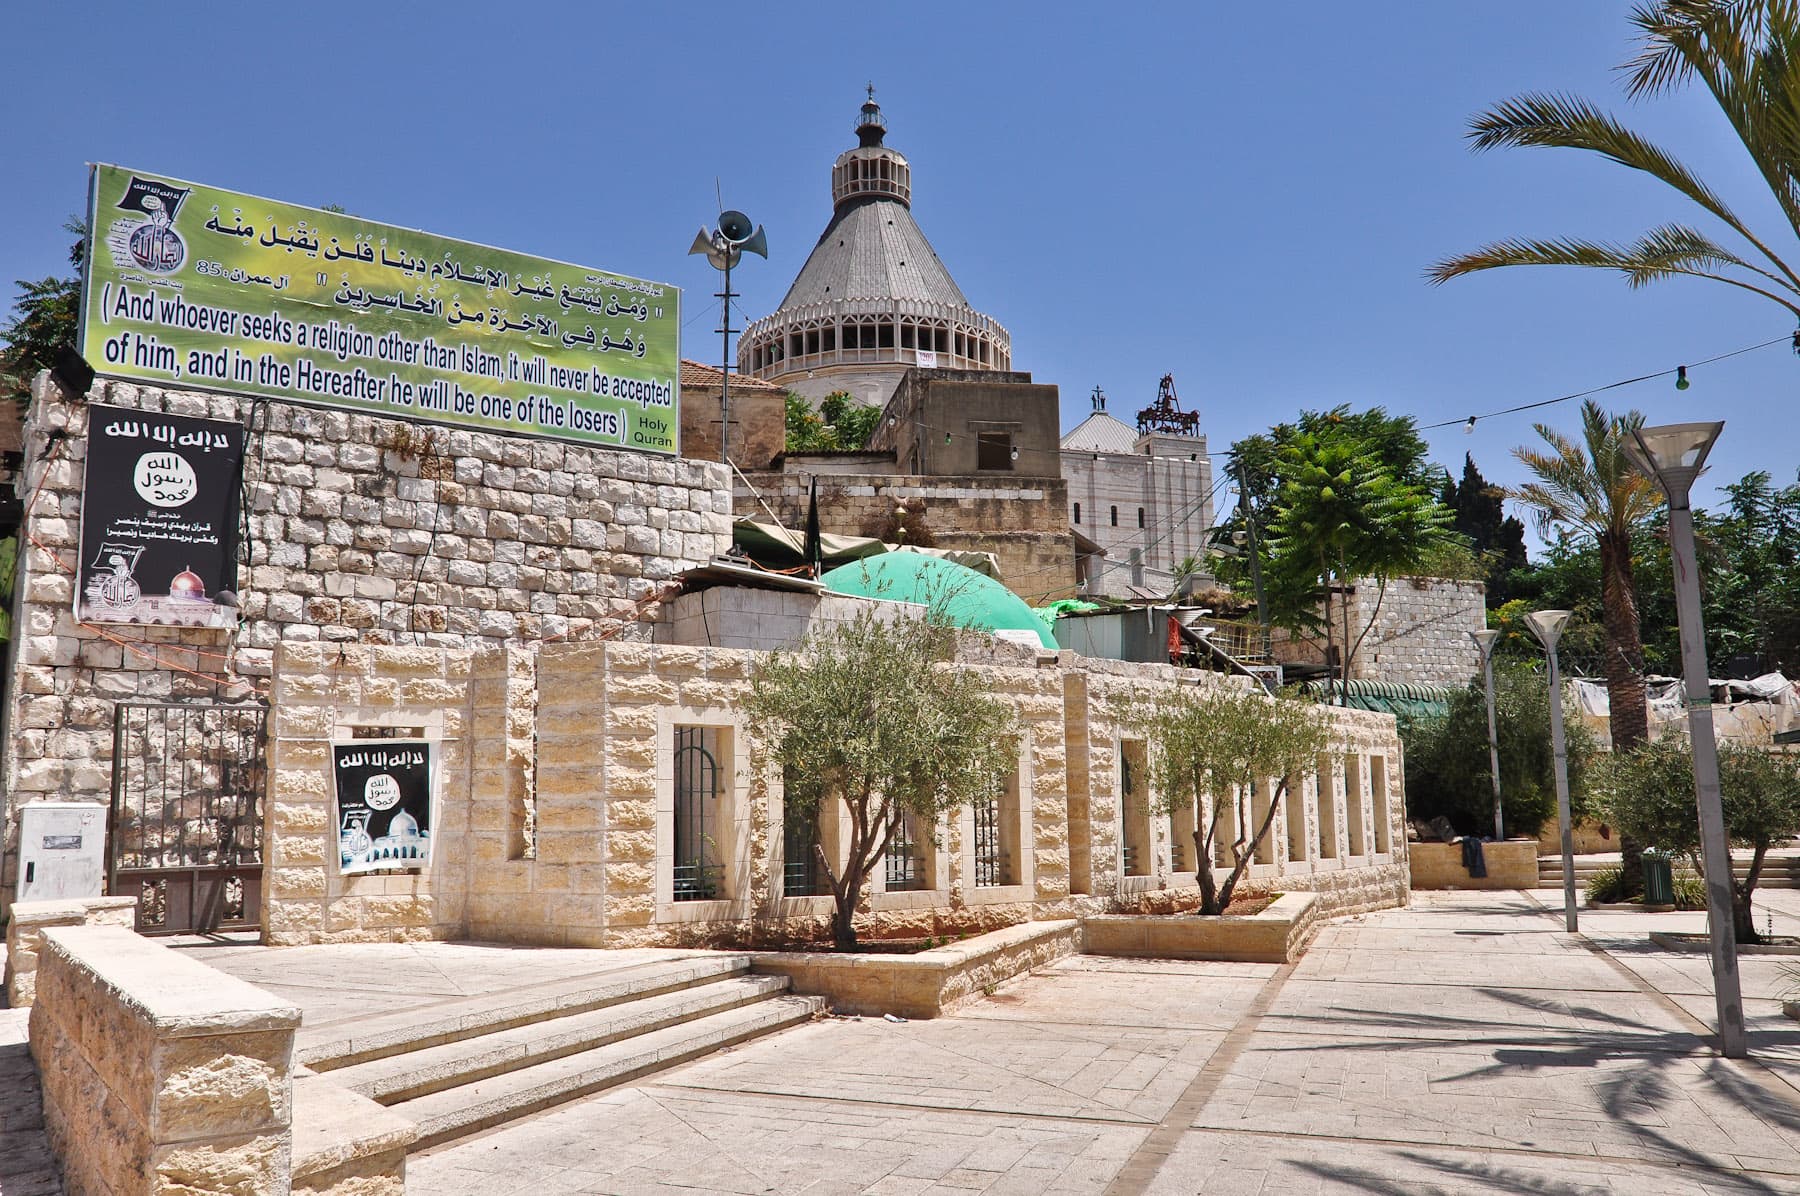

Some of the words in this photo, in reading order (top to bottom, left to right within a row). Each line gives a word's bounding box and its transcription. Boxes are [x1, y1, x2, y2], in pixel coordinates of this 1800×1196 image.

[159, 294, 238, 335] whoever
[241, 311, 293, 344] seeks
[297, 322, 307, 346] a
[312, 319, 374, 361] religion
[378, 331, 420, 363] other
[423, 338, 457, 370] than
[461, 343, 505, 384] Islam,
[508, 351, 519, 380] it
[522, 356, 546, 385] will
[549, 364, 589, 392] never
[592, 366, 609, 395] be
[612, 376, 672, 408] accepted
[105, 331, 130, 364] of
[134, 334, 181, 379] him,
[188, 348, 229, 379] and
[234, 350, 252, 382] in
[259, 354, 291, 387] the
[297, 359, 386, 400] Hereafter
[391, 374, 413, 405] he
[418, 381, 449, 411] will
[454, 383, 475, 414] be
[480, 395, 512, 420] one
[517, 395, 536, 422] of
[539, 397, 564, 427] the
[104, 420, 149, 438] الله
[639, 416, 668, 433] Holy
[213, 433, 229, 448] لا
[633, 431, 672, 448] Quran
[147, 456, 179, 470] الله
[141, 472, 192, 487] رسول
[154, 489, 189, 501] محمد
[340, 751, 369, 768] الله
[412, 751, 424, 765] لا
